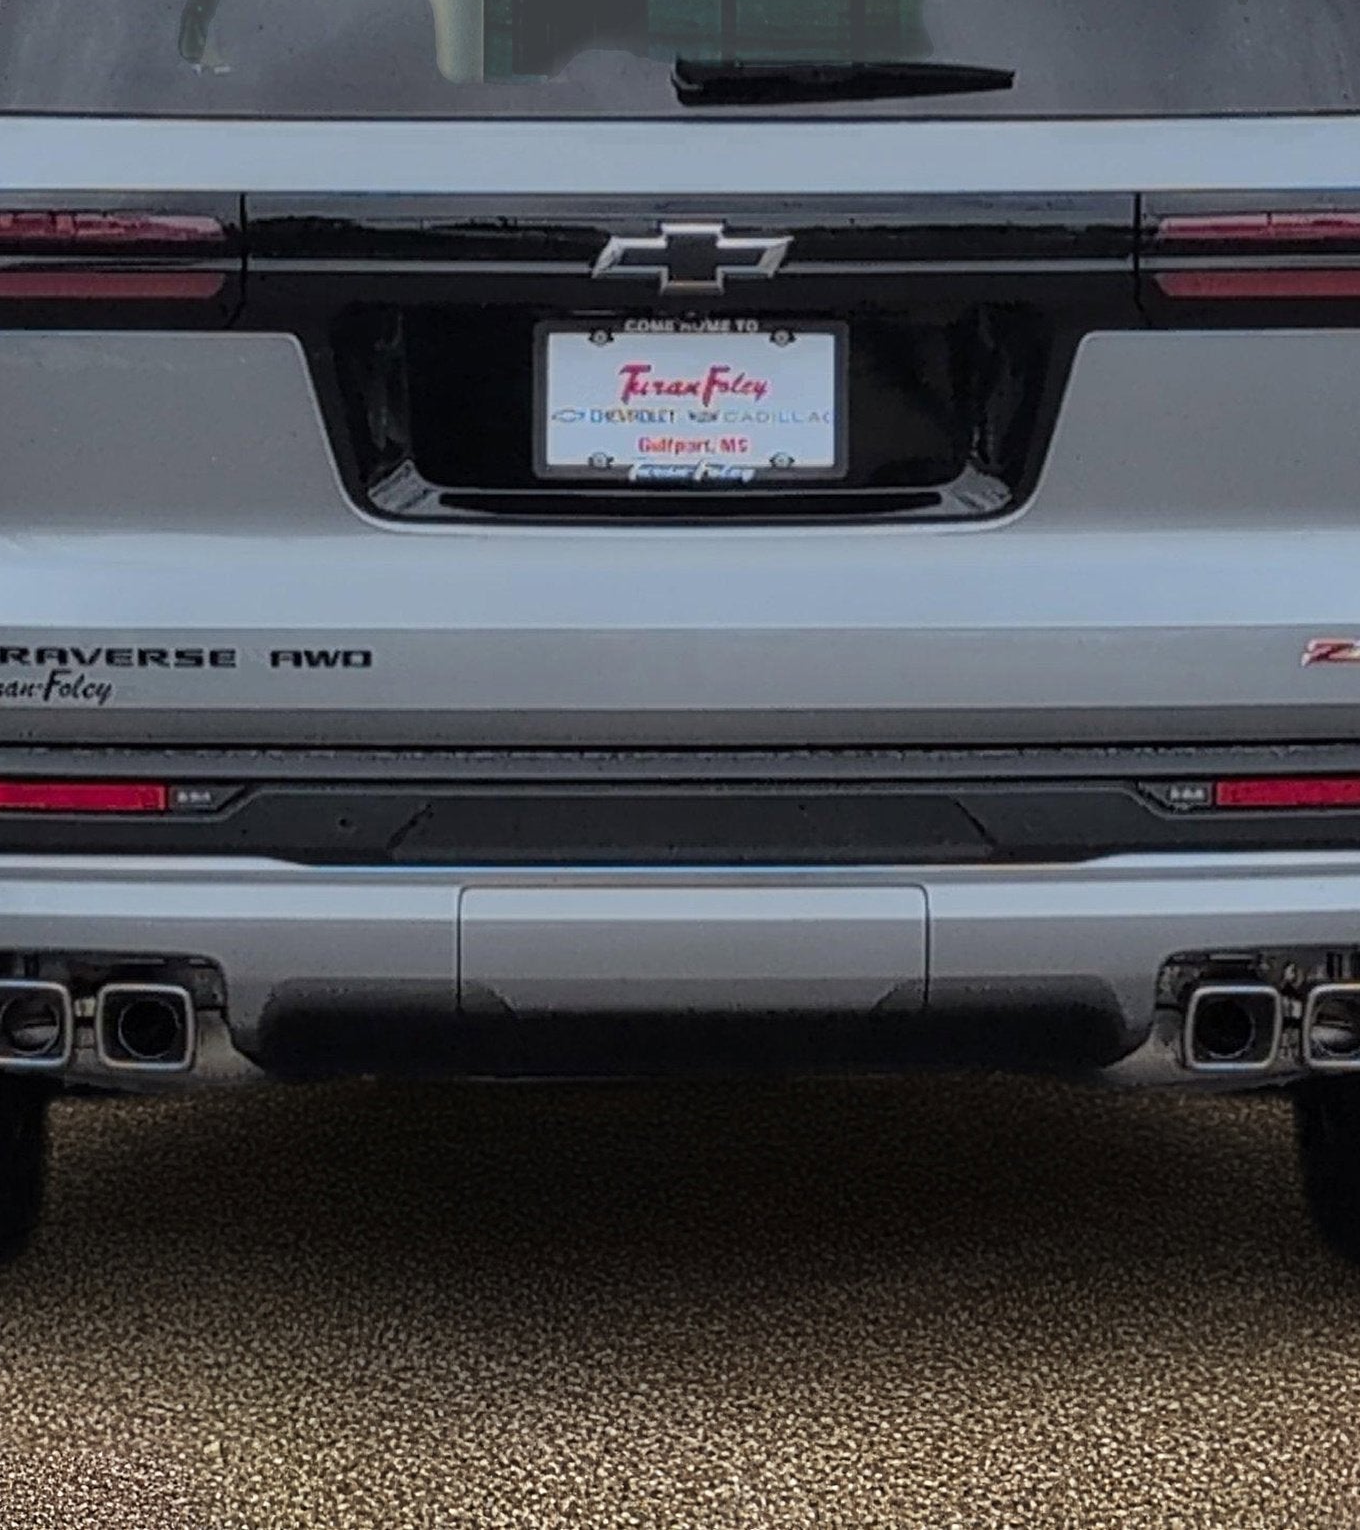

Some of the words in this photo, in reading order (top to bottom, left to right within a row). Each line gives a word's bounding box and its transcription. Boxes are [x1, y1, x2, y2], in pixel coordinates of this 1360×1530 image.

[734, 318, 759, 332] TO
[720, 438, 748, 452] MS
[270, 649, 373, 668] AWD
